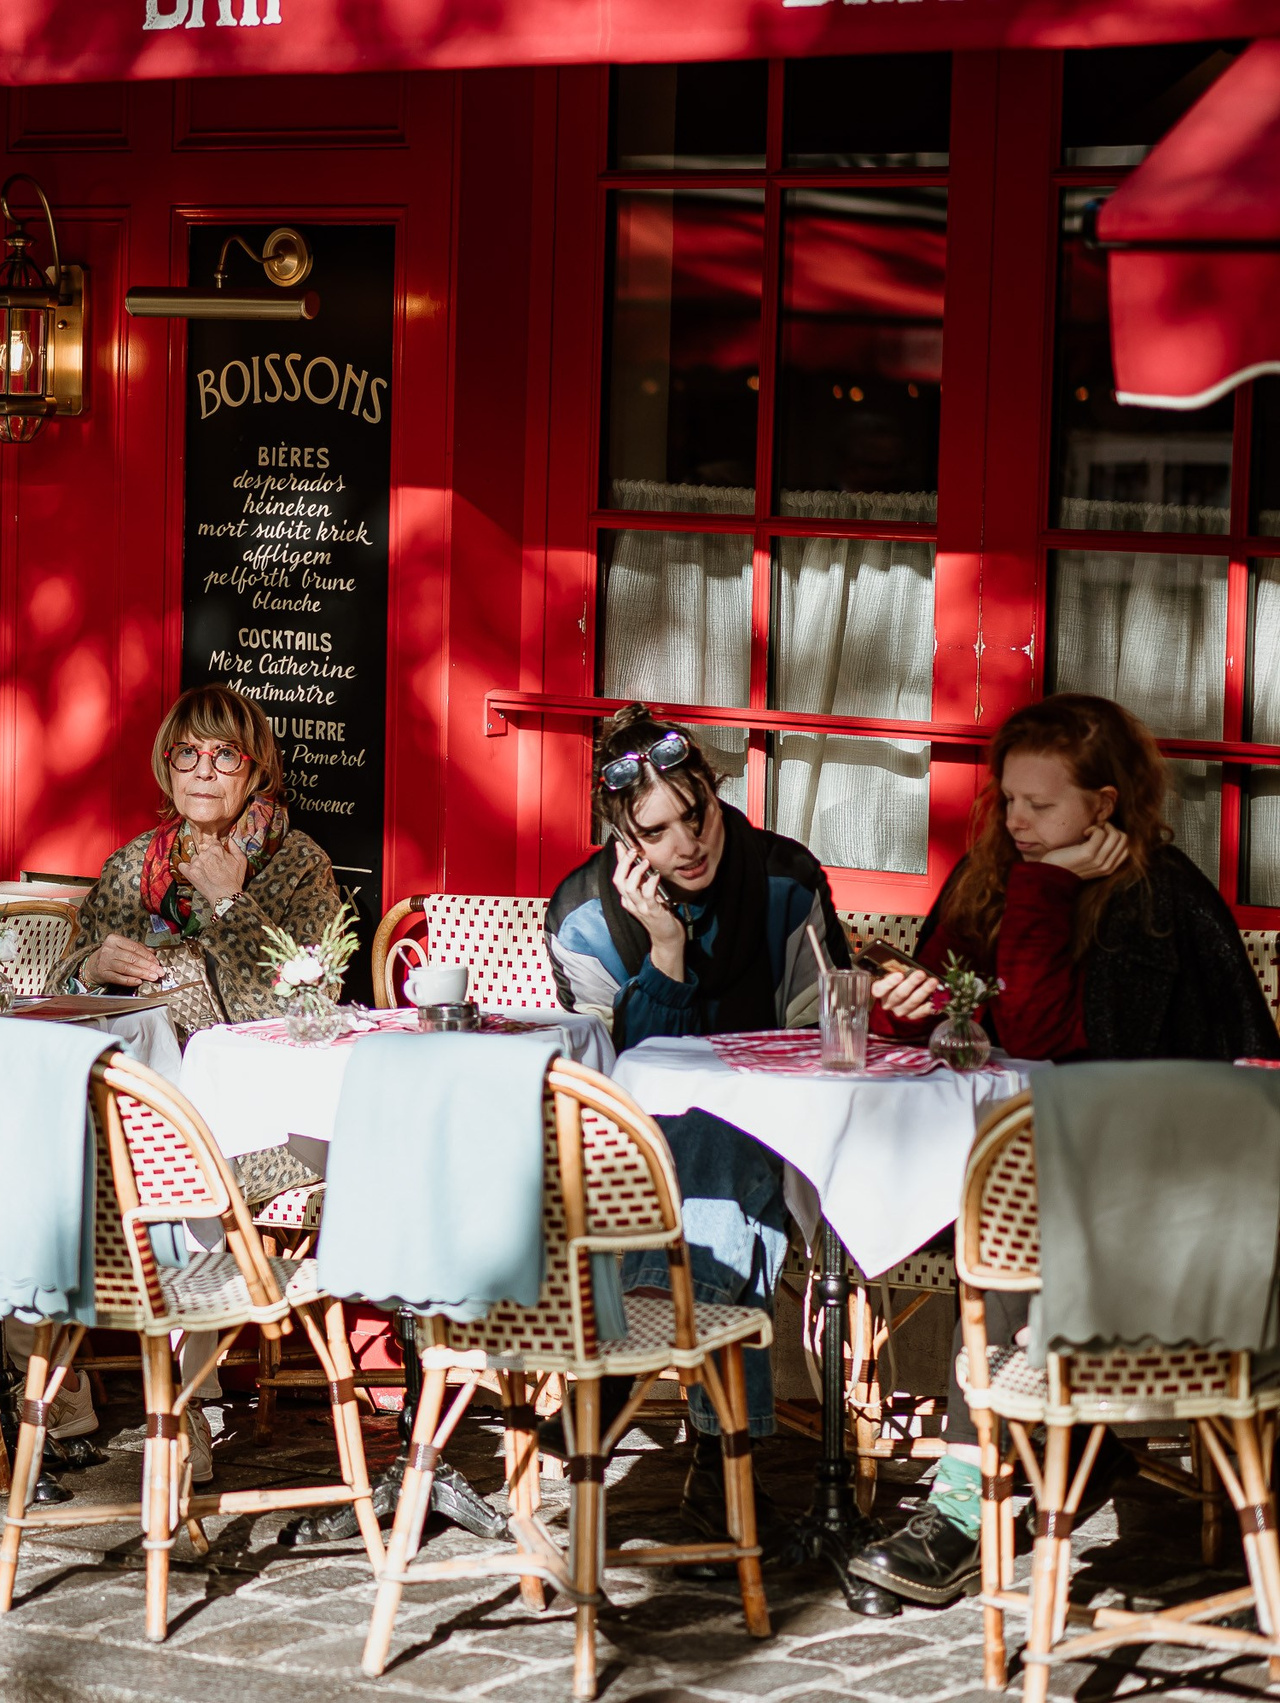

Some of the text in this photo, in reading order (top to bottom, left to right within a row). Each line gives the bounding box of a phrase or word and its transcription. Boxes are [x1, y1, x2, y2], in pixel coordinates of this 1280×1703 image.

[197, 353, 388, 424] BOISSONS
[258, 441, 330, 468] BIÈRES
[233, 470, 346, 499] desperados
[242, 493, 332, 517] heineken
[198, 519, 373, 545] mort subite kriek
[242, 543, 332, 571] affligem
[204, 566, 356, 594] pelforth brune
[252, 591, 322, 612] blanche
[238, 627, 332, 652] COCKTAILS
[208, 650, 358, 679] Mère Catherine
[226, 678, 338, 705] Montmartre
[293, 743, 366, 767] Pomerol
